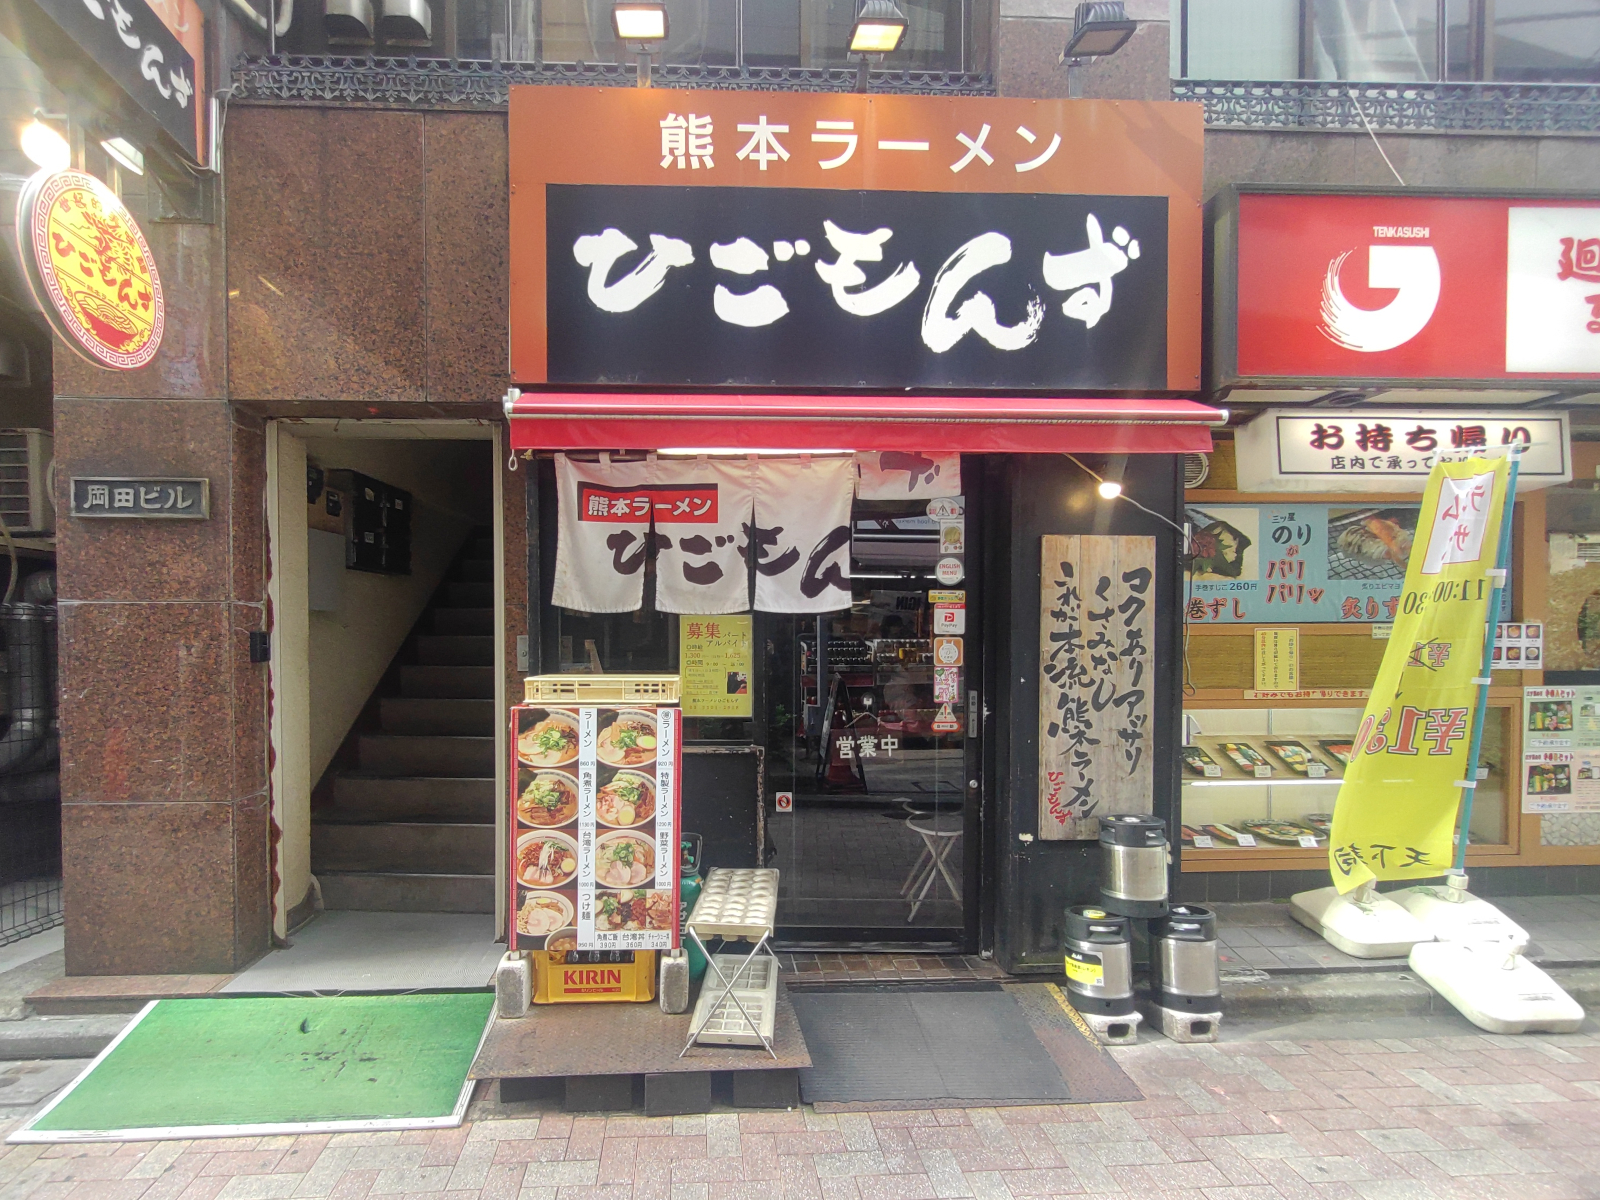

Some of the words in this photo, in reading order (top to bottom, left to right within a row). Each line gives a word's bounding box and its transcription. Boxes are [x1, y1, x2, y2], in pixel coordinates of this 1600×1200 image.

[659, 113, 1062, 173] 熊本ラーメン
[1373, 226, 1430, 238] TENKASUSHI
[573, 213, 1140, 353] ひごもんず
[1309, 423, 1532, 454] お持ち帰り
[83, 485, 193, 509] 岡田ビル
[588, 495, 712, 517] 熊本ラーメン
[1271, 512, 1296, 524] 三ツ星
[1271, 524, 1312, 546] のり
[1286, 544, 1299, 558] が
[1229, 582, 1257, 591] 260円
[687, 622, 720, 640] 募集
[584, 712, 592, 748] ラーメン
[836, 734, 898, 759] 営業中
[582, 772, 592, 817] 角煮ラーメン
[660, 772, 670, 817] 特製ラーメン
[582, 831, 592, 878] 台湾ラーメン
[660, 832, 668, 877] 野菜ラーメン
[582, 893, 591, 920] つけ麺
[564, 970, 622, 986] KIRIN
